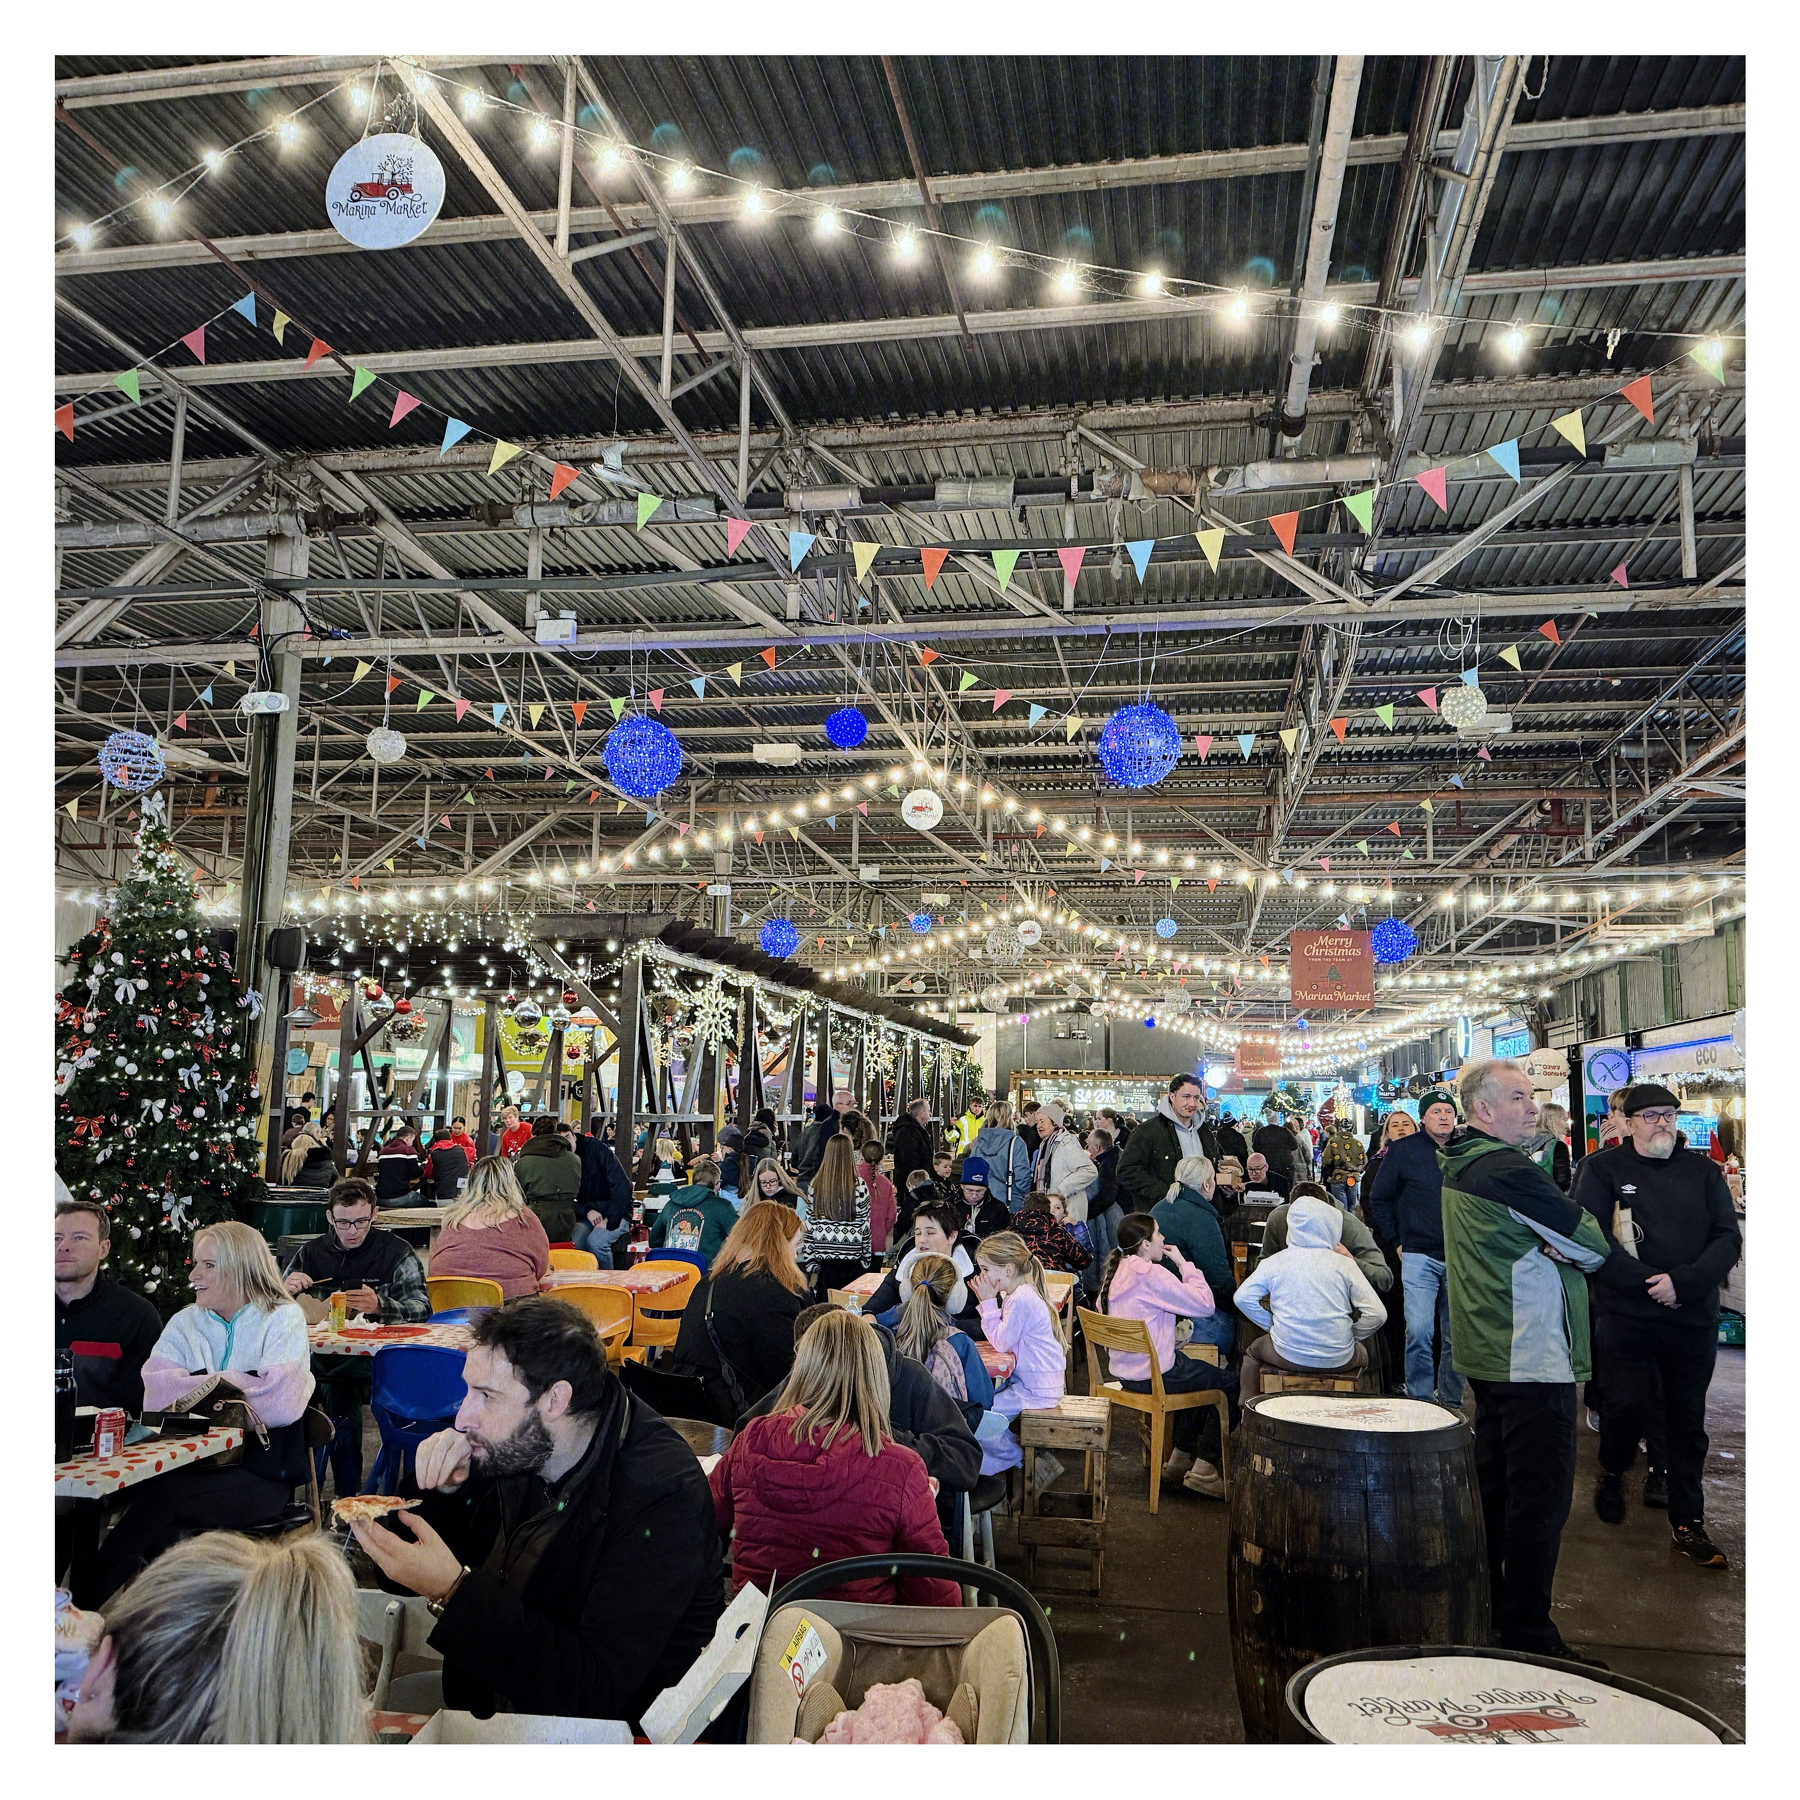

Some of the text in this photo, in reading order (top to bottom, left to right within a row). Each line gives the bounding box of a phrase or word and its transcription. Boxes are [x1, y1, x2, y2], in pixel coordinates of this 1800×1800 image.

[332, 194, 428, 220] Marina Market
[1304, 944, 1362, 956] Christmas
[1313, 935, 1353, 948] Merry
[1294, 990, 1371, 1001] Marina Market
[1695, 1045, 1717, 1066] eco
[792, 1624, 807, 1649] AIRBAG
[1347, 1687, 1598, 1726] Marina Market
